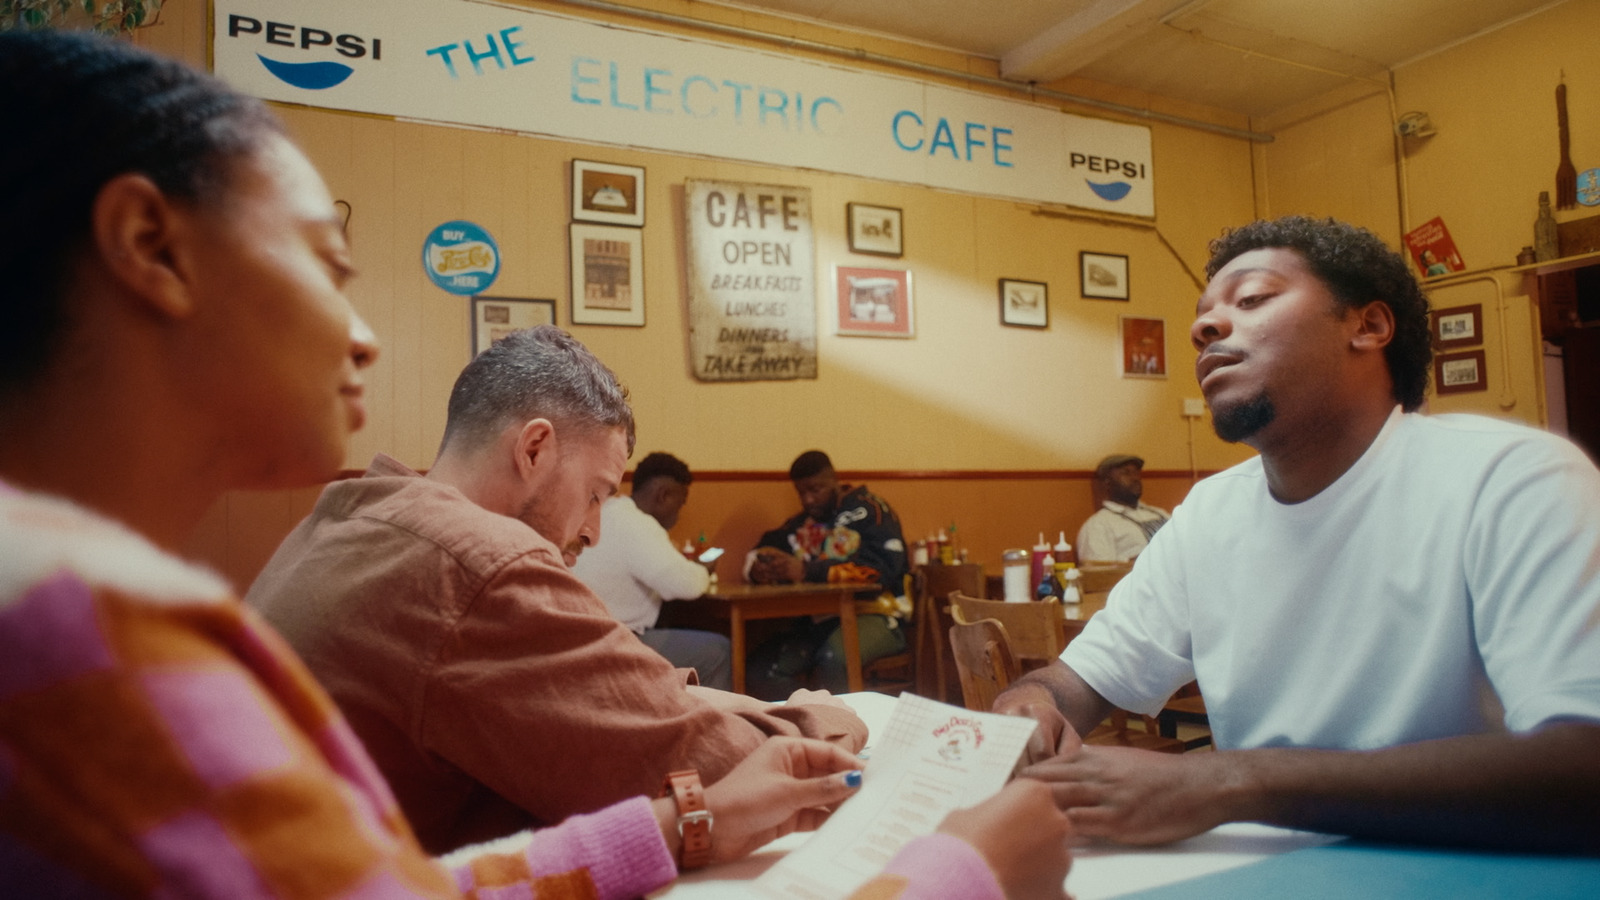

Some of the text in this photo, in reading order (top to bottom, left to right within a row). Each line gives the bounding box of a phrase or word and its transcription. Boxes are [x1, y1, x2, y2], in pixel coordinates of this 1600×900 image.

[228, 14, 382, 61] PEPSI
[426, 25, 1014, 168] THE ELECTRIC CAFE
[1070, 152, 1146, 179] PEPSI
[706, 191, 799, 232] CAFE
[723, 240, 791, 266] OPEN
[711, 274, 803, 292] BREAKFASTS
[726, 301, 788, 317] LUNCHES
[718, 327, 789, 343] DINNERS
[703, 354, 804, 374] TAKE AWAY
